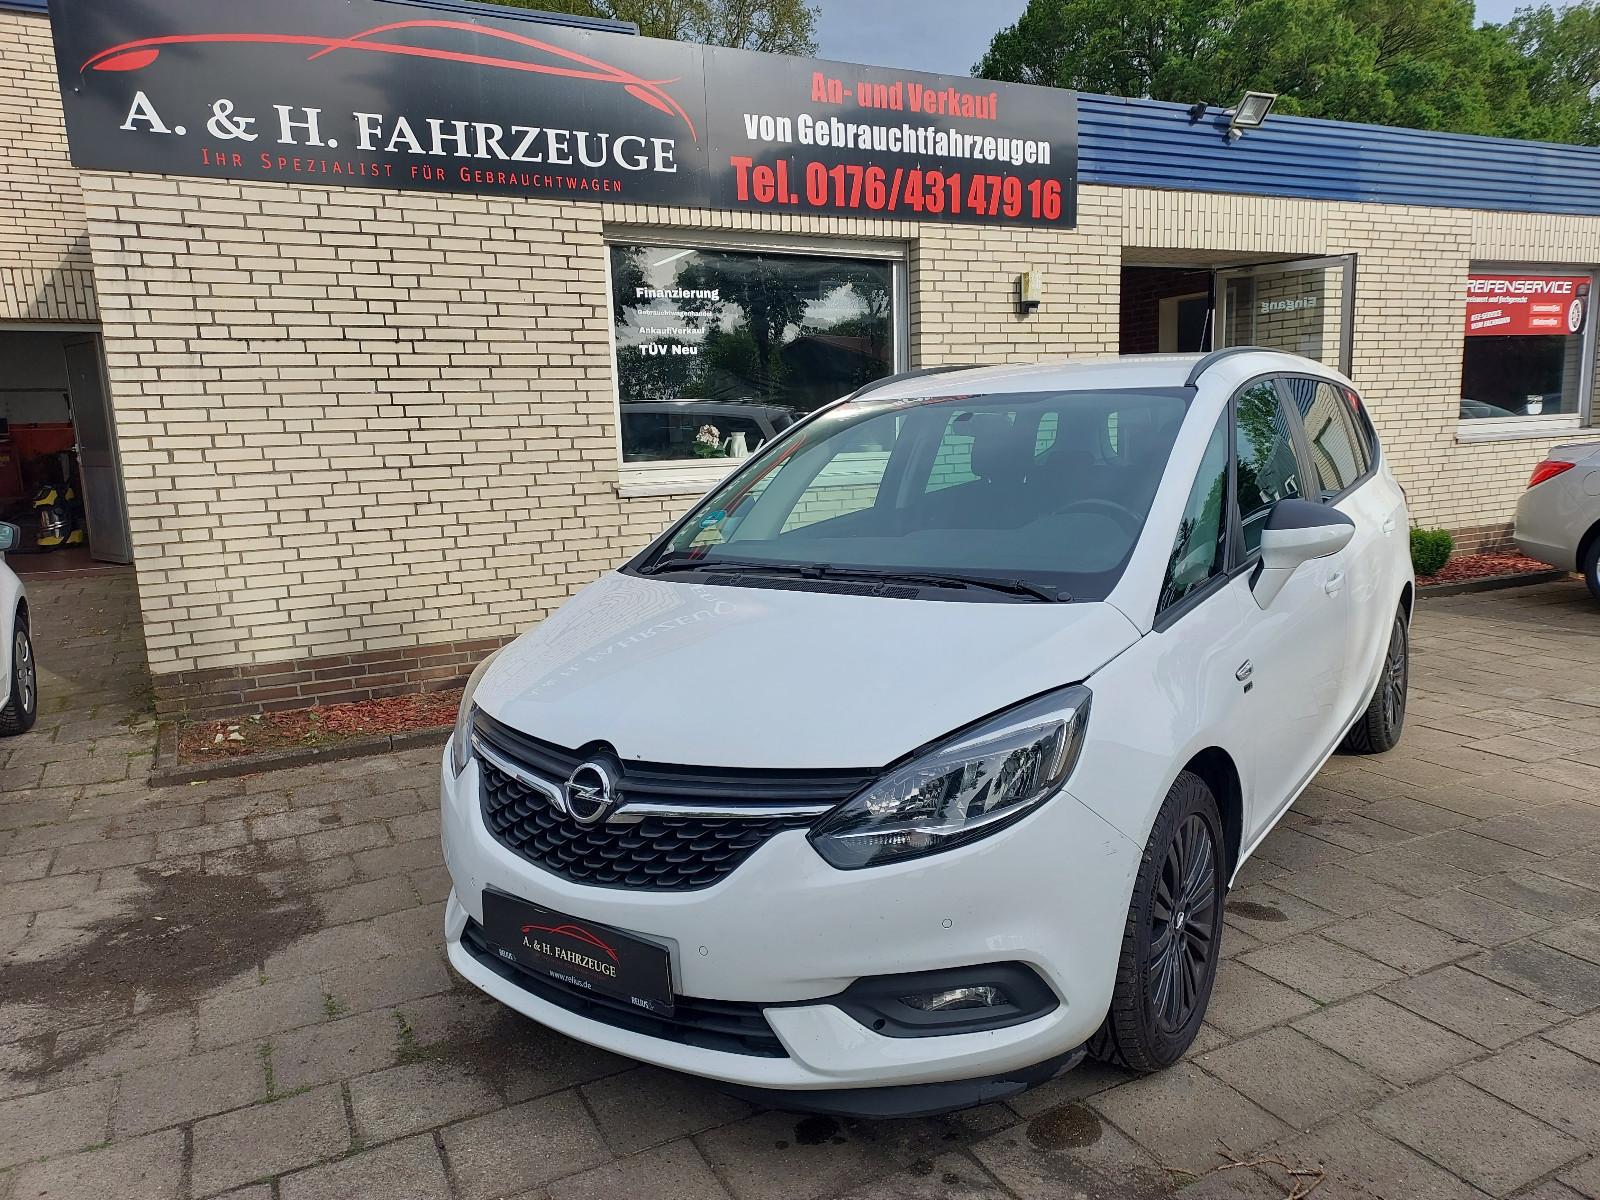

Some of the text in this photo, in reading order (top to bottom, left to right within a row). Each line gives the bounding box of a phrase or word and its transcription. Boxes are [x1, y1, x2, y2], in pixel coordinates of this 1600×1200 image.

[811, 71, 998, 120] An- und Verkauf
[119, 91, 678, 173] A. & H. FAHRZEUGE
[743, 113, 1051, 165] von Gebrauchtfahrzeugen
[202, 149, 623, 192] IHR SPEZIALIST FÜR GEBRAUCHTWAGEN
[730, 156, 798, 204] Tel.
[967, 174, 1022, 217] 479
[1028, 178, 1062, 220] 16
[636, 287, 720, 301] Finanzierung
[1467, 280, 1572, 294] REIFENSERVICE
[639, 342, 698, 355] TÜV Neu
[522, 936, 616, 977] A. & H. FAHRZEUGE
[549, 969, 592, 990] www.relius.de
